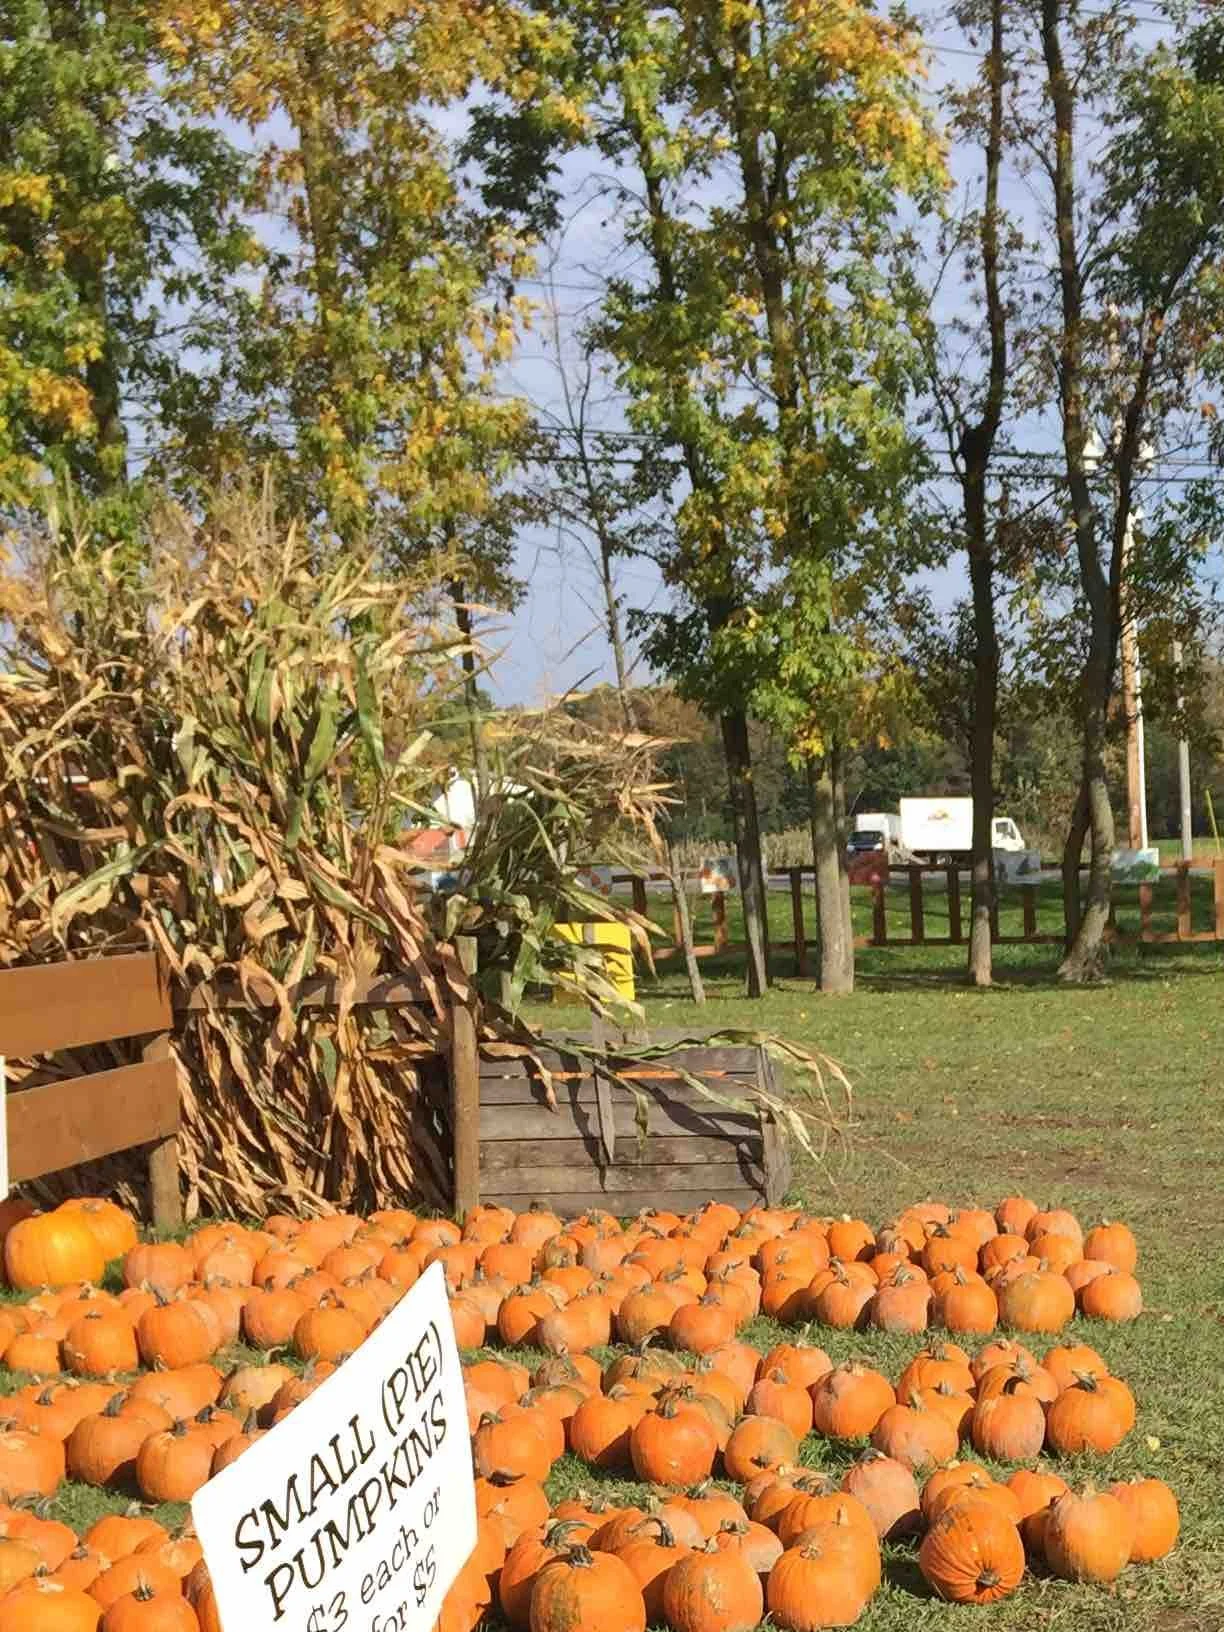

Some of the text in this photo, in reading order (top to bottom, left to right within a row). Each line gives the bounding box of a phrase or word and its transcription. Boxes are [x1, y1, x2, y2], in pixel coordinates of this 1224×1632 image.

[234, 1320, 443, 1573] SMALL (PIE)
[263, 1390, 447, 1622] PUMPKINS
[360, 1524, 419, 1605] each
[423, 1486, 441, 1529] or
[412, 1543, 437, 1608] $5
